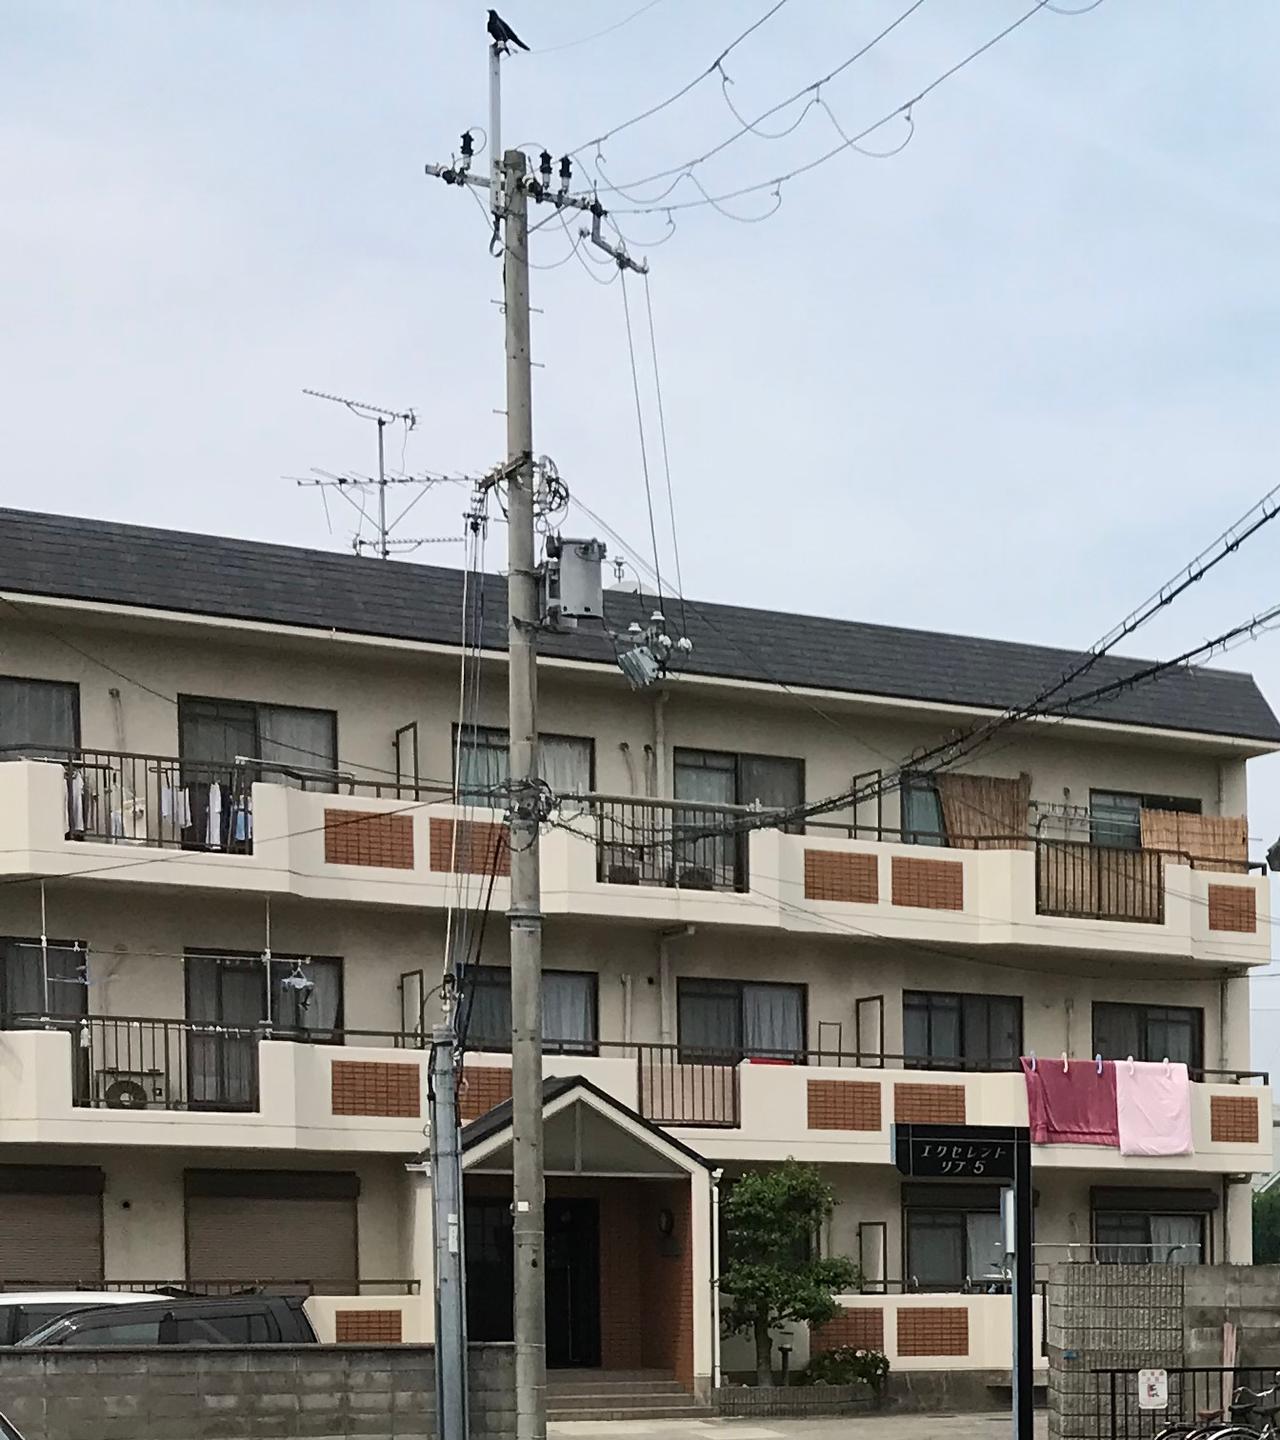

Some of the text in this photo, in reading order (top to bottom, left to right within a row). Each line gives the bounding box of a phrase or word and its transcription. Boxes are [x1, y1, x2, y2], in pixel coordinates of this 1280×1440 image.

[920, 1144, 1007, 1160] エクセレント
